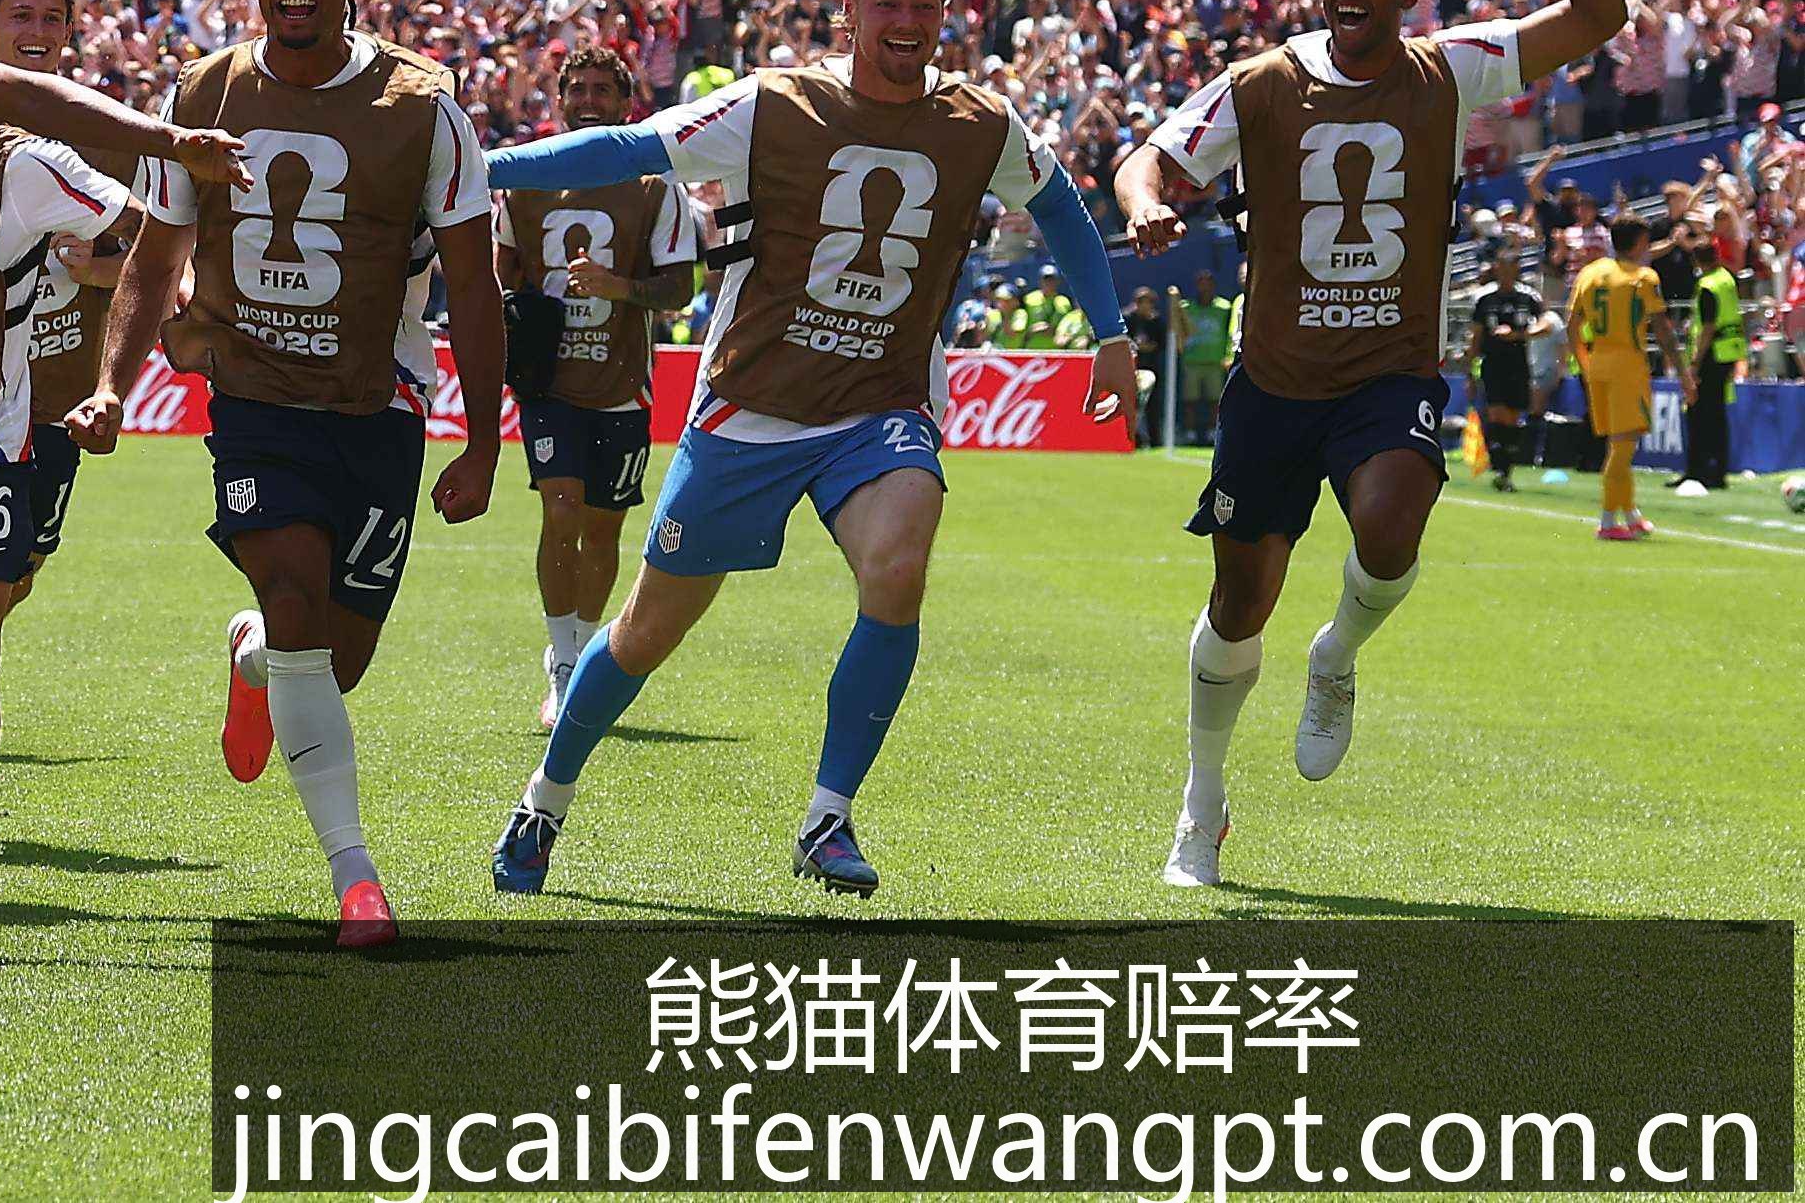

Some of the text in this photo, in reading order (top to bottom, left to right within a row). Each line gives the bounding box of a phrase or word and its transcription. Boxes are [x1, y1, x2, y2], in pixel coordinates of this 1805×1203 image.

[1330, 250, 1378, 268] FIFA
[259, 269, 310, 291] FIFA
[835, 277, 883, 302] FIFA
[1300, 285, 1403, 303] WORLD CUP
[52, 310, 82, 331] CUP
[235, 302, 340, 330] WORLD CUP
[795, 306, 896, 338] WORLD CUP
[1298, 303, 1402, 329] 2026
[584, 331, 611, 343] CUP
[783, 323, 886, 361] 2026
[557, 343, 609, 363] 026
[1418, 399, 1435, 431] 6
[615, 447, 646, 490] 10
[345, 506, 407, 579] 12
